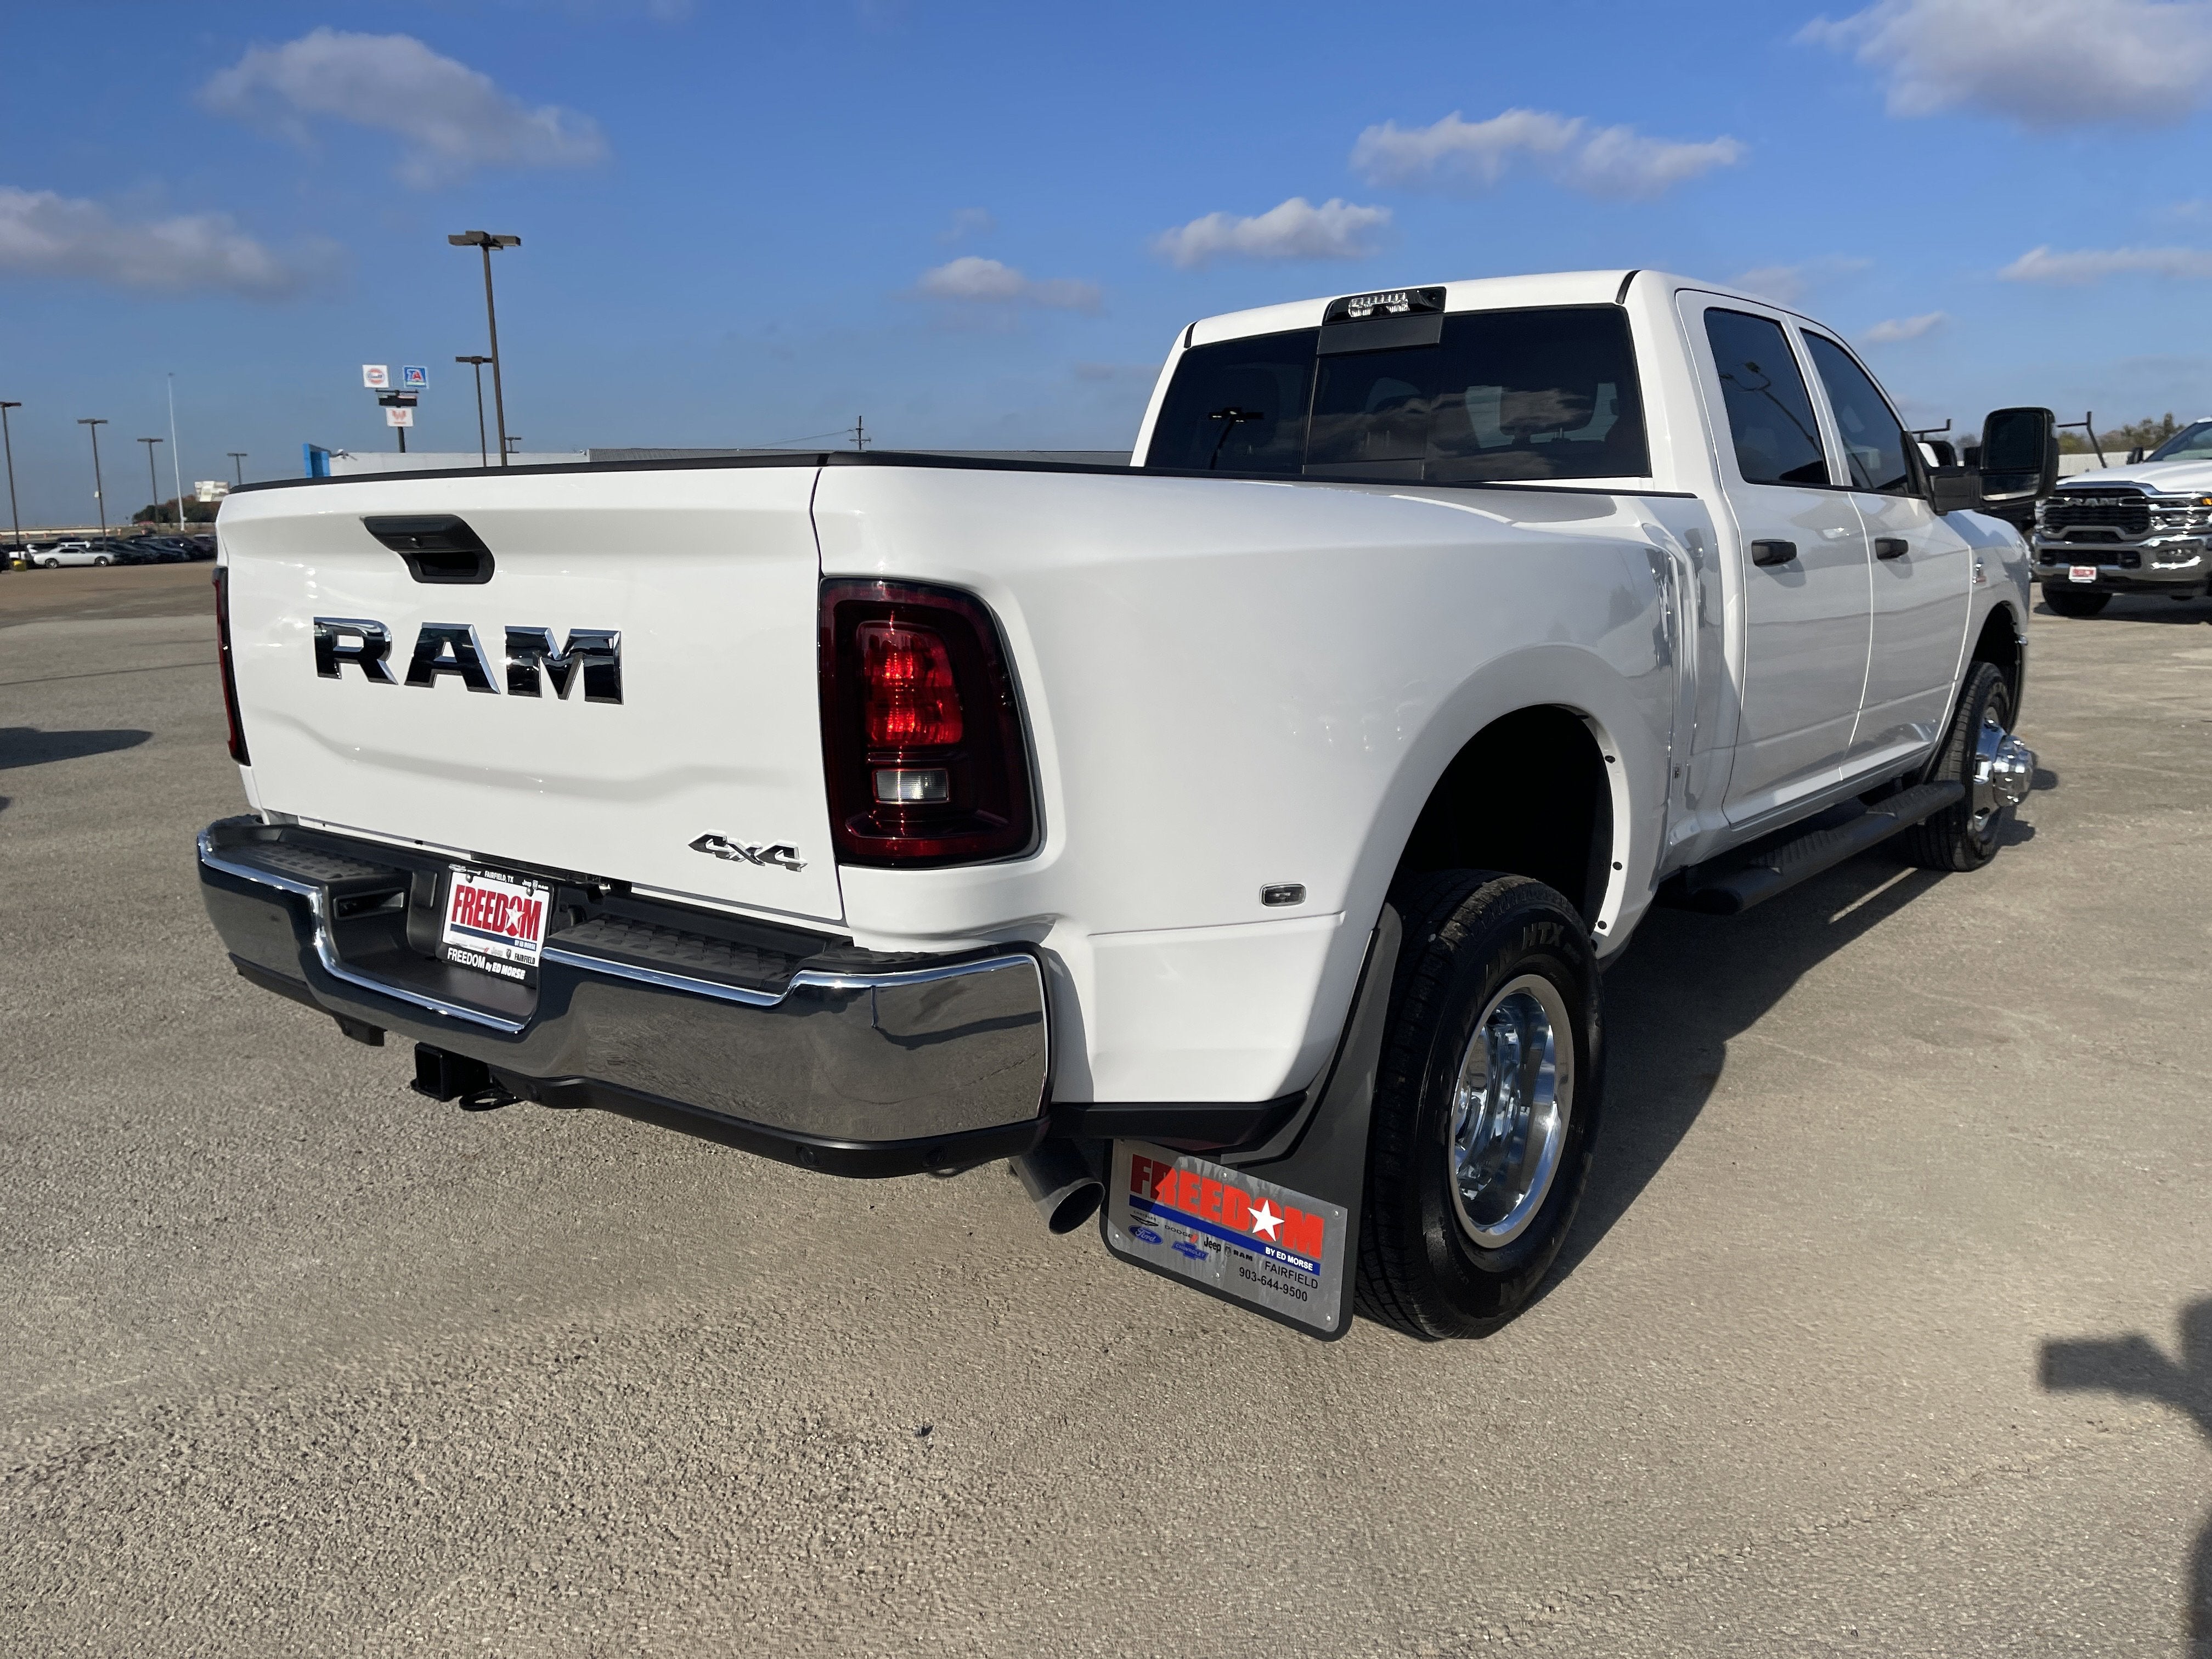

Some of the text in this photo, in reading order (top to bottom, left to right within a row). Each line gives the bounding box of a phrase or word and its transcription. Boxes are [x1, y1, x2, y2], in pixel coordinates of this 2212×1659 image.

[313, 617, 624, 705] RAM
[484, 871, 506, 883] FAIRFIELD,
[507, 875, 514, 883] TX
[452, 884, 542, 941] FREEDOM
[447, 947, 486, 969] FREEDOM
[485, 962, 492, 972] by
[492, 962, 501, 973] ED
[501, 964, 526, 980] MORSE
[515, 953, 535, 964] FAIRFIELD
[1130, 1154, 1325, 1260] FREEDOM
[1135, 1228, 1157, 1243] Ford
[1165, 1225, 1193, 1238] DODGE
[1175, 1243, 1205, 1258] CHEVROLET
[1204, 1237, 1221, 1253] Jeep
[1234, 1250, 1252, 1261] RAM
[1265, 1246, 1313, 1271] BY ED MORSE
[1239, 1267, 1308, 1302] 903-644-9500
[1265, 1261, 1318, 1289] FAIRFIELD
